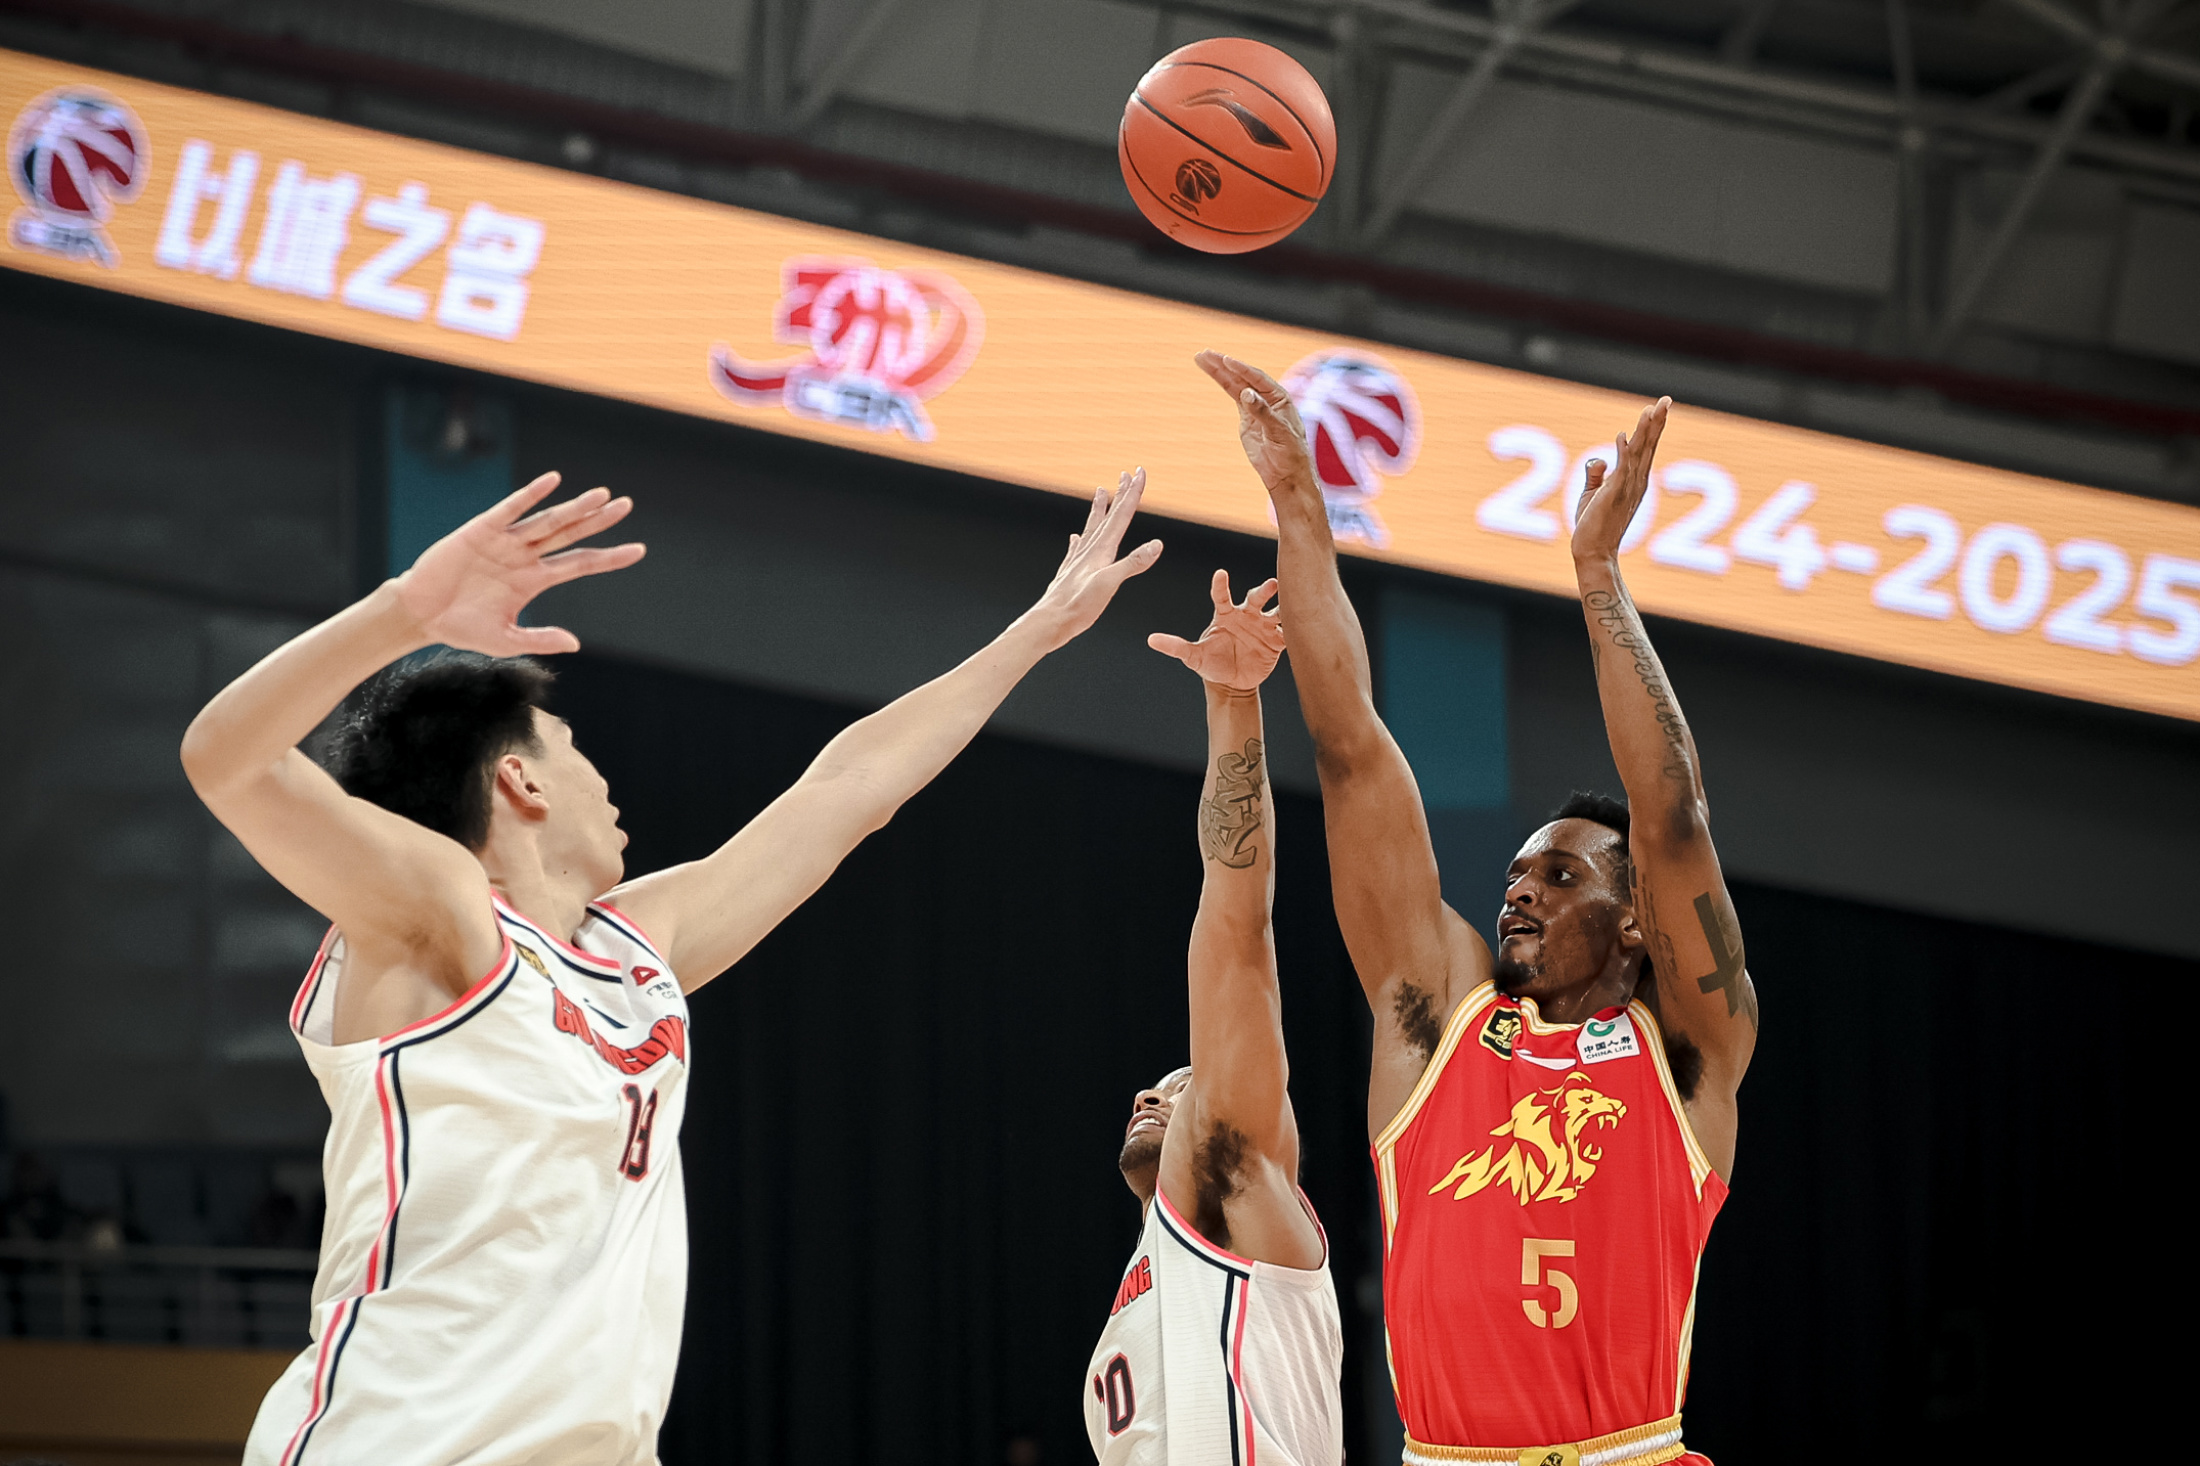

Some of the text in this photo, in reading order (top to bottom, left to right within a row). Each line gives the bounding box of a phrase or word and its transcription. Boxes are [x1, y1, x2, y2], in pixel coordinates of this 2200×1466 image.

[1475, 424, 2200, 665] 2024-2025
[1586, 1045, 1633, 1059] CHINA LIFE
[1521, 1237, 1579, 1329] 5
